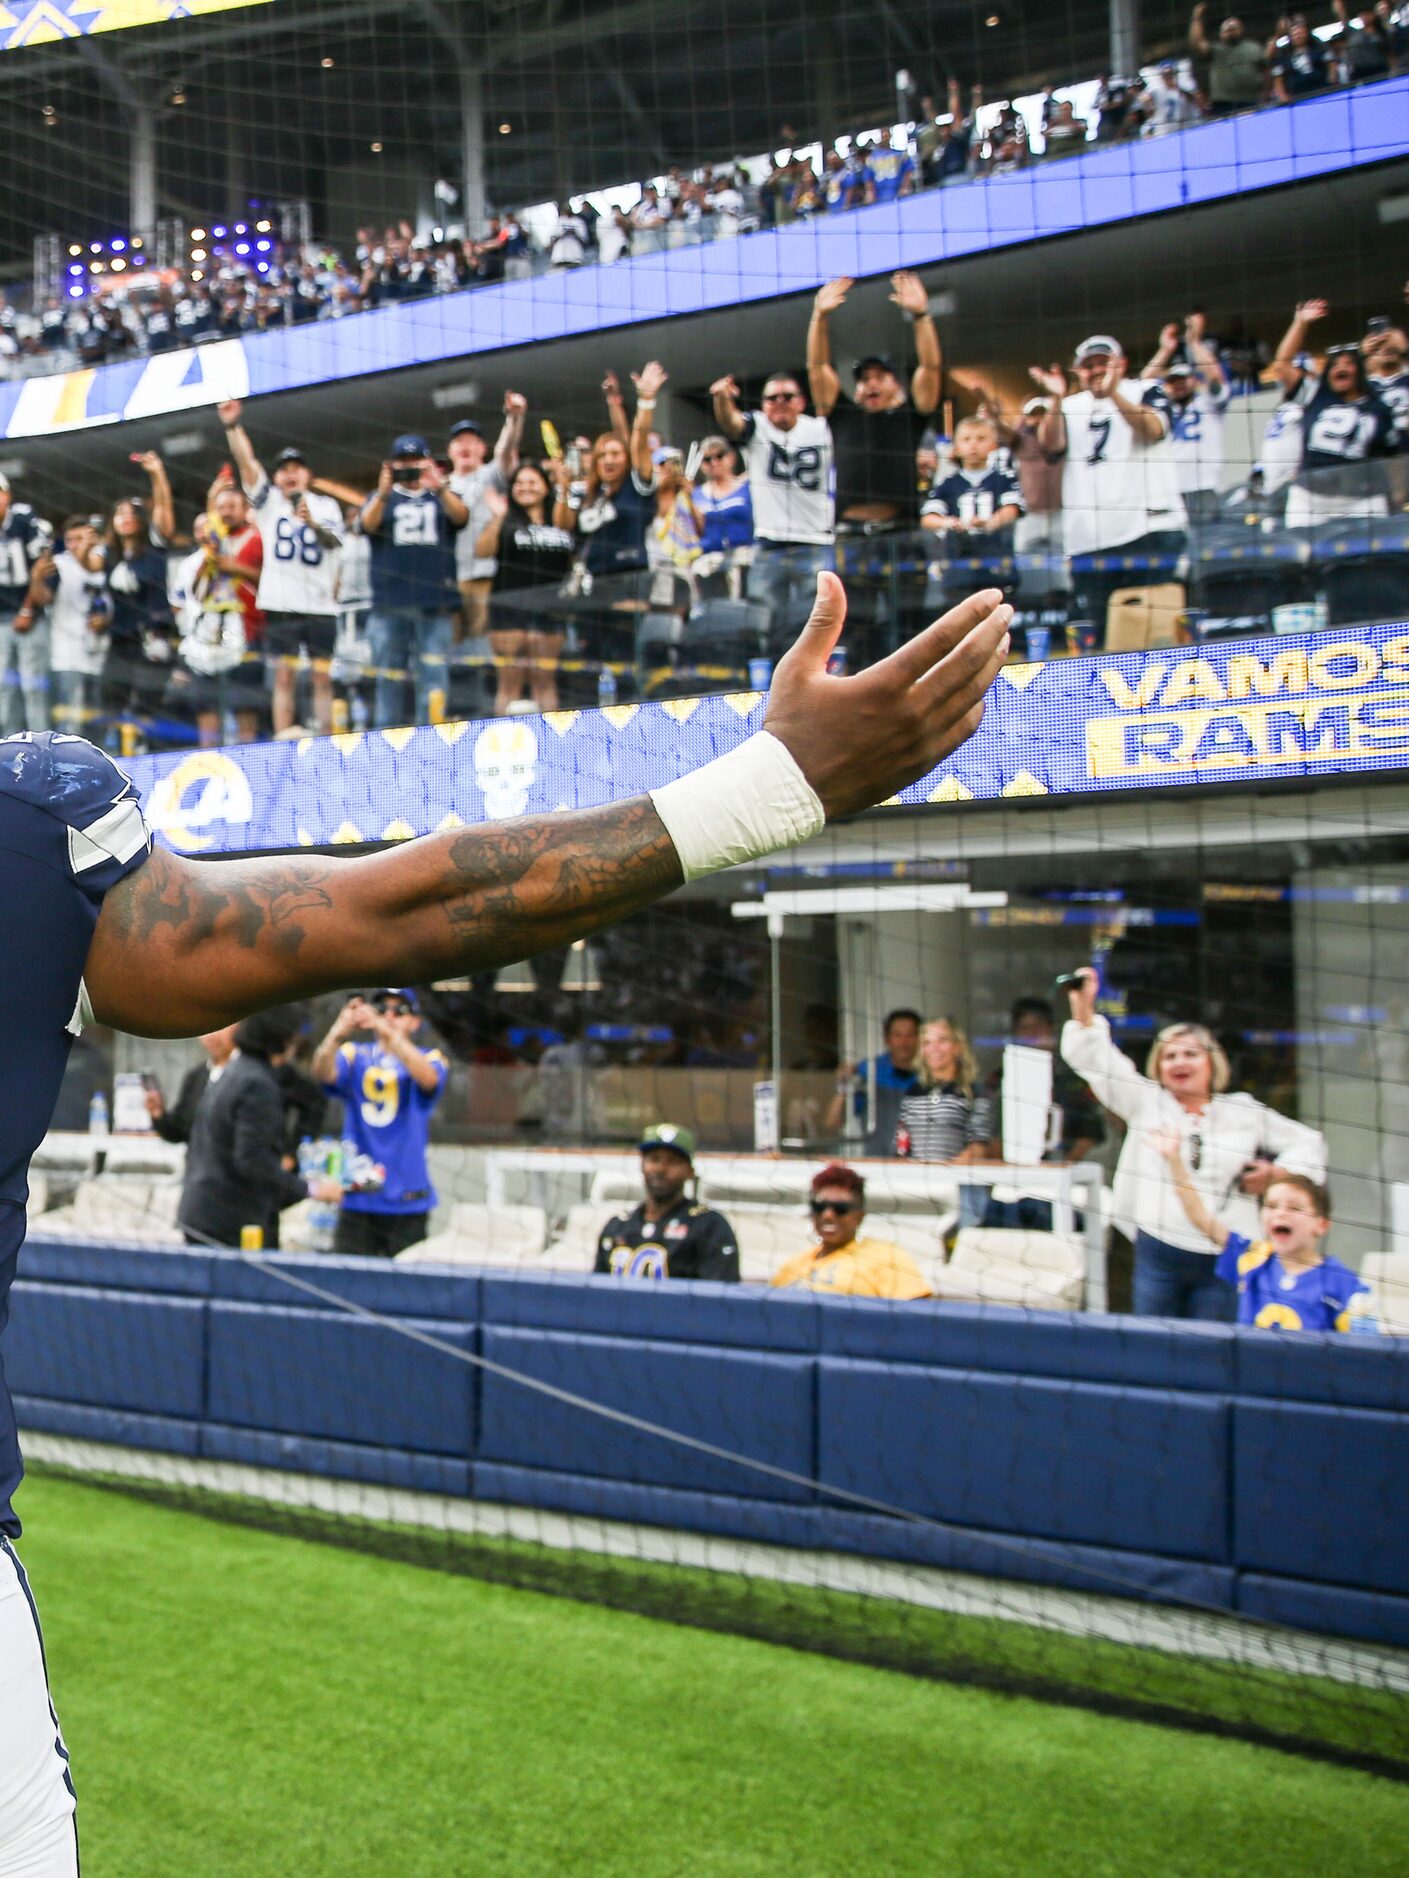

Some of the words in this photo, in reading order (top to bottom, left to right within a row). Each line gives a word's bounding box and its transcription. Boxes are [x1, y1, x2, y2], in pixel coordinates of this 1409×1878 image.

[1086, 416, 1111, 466] 7
[275, 517, 322, 566] 88
[393, 502, 439, 546] 21
[361, 1066, 400, 1128] 9
